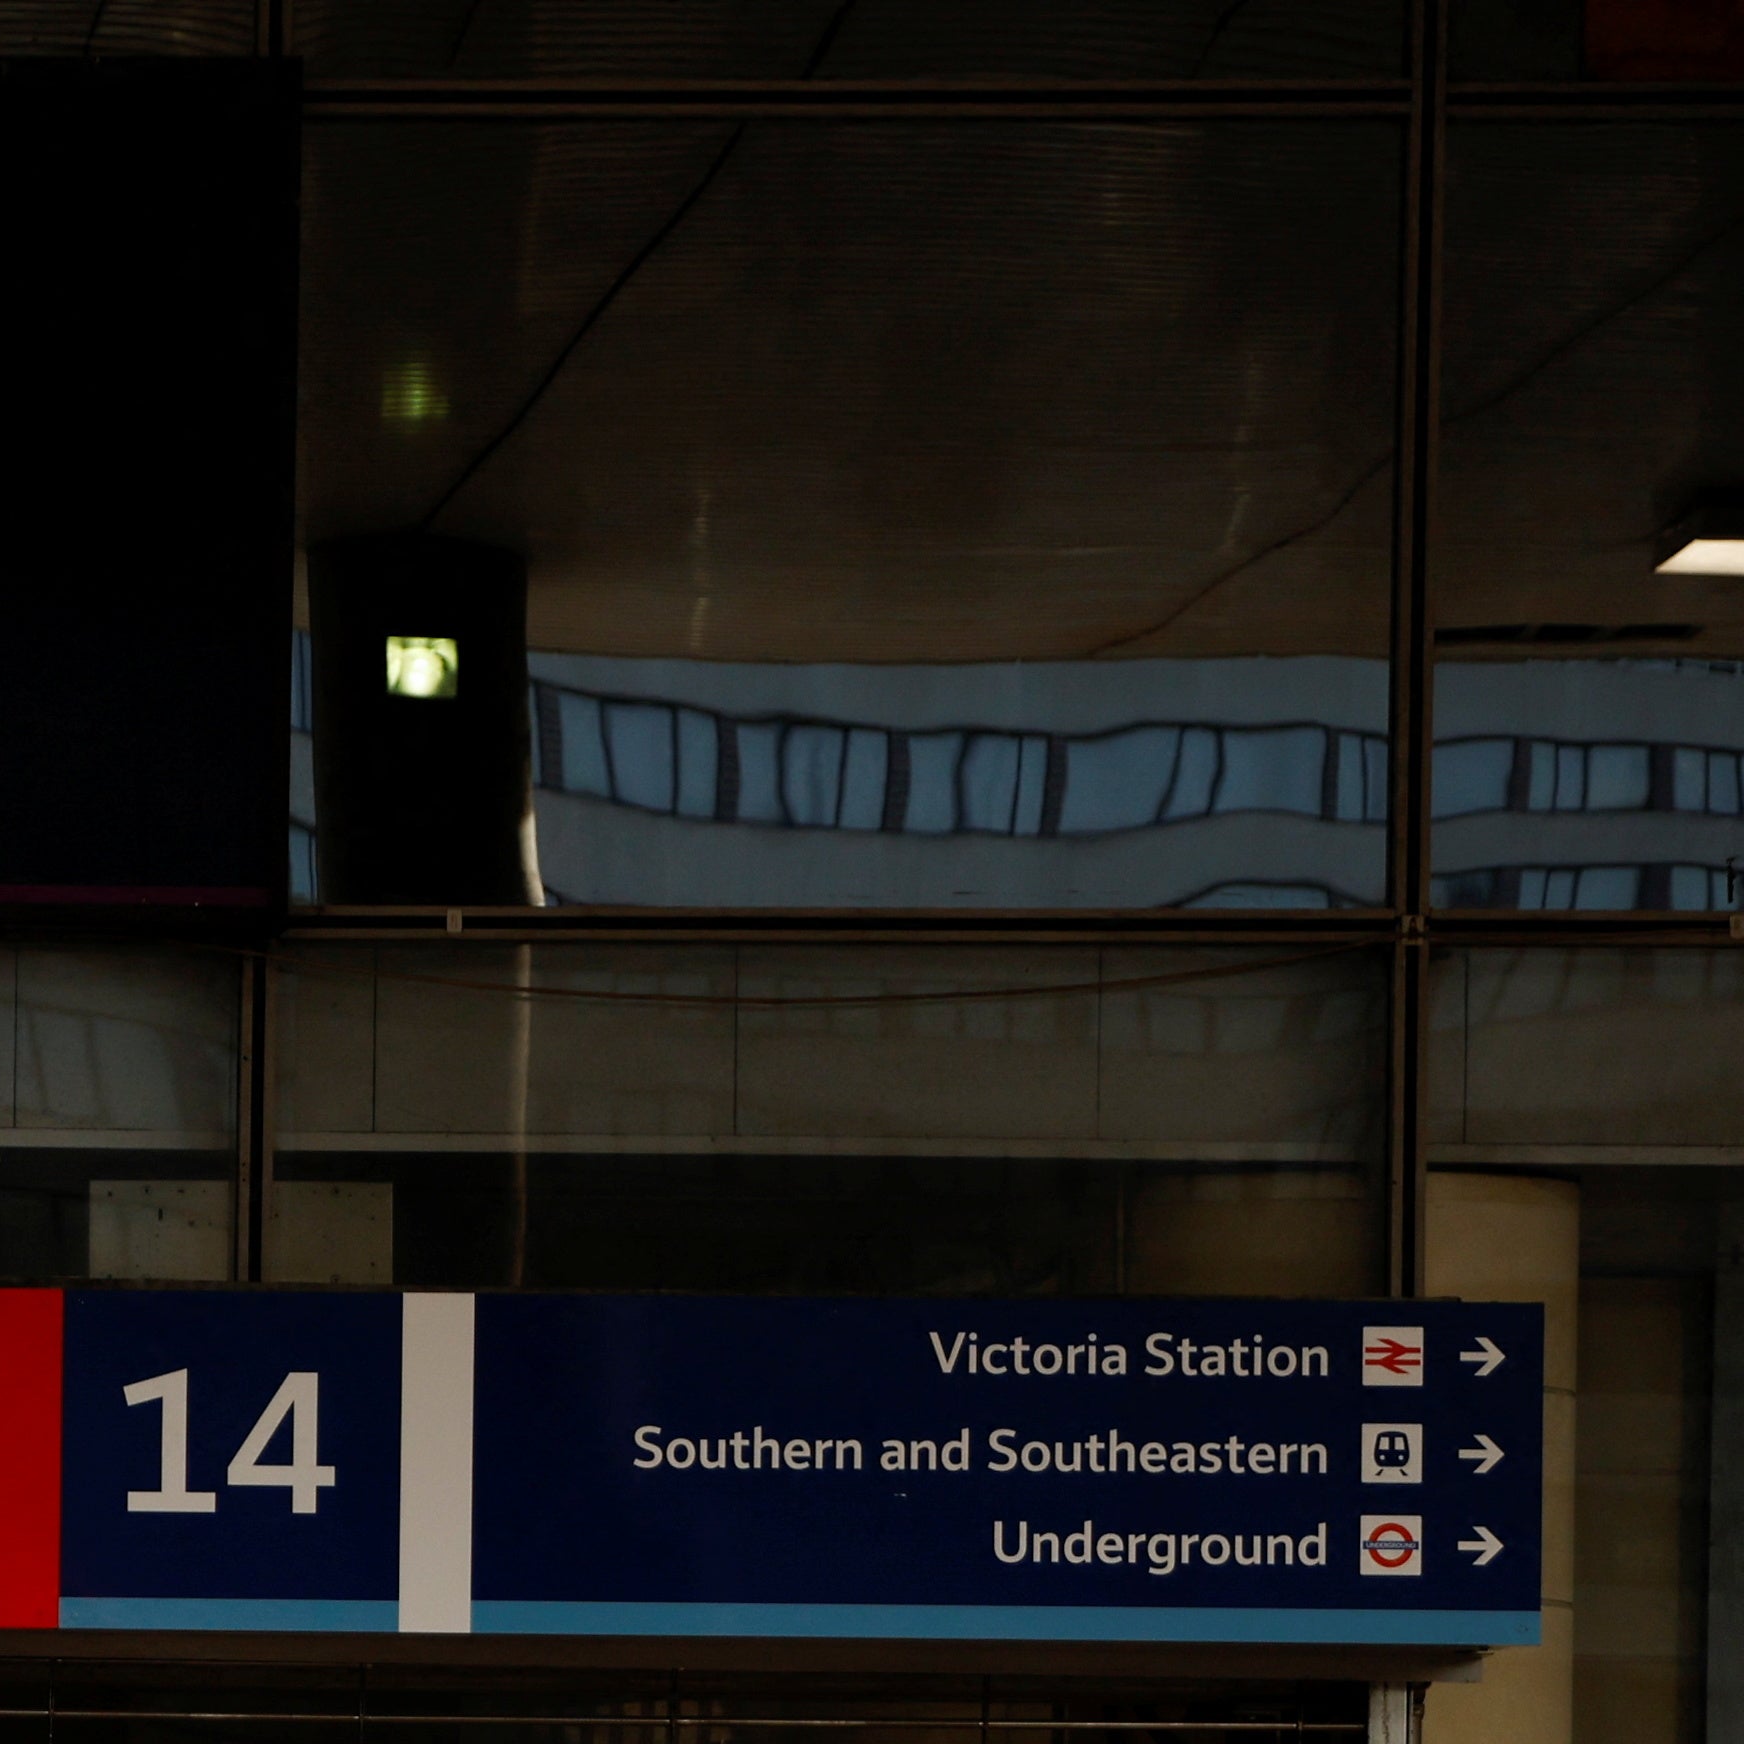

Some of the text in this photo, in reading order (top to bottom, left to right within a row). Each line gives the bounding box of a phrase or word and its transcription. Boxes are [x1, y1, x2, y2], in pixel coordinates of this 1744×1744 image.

[928, 1331, 1330, 1377] Victoria Station
[122, 1367, 337, 1514] 14
[632, 1425, 1329, 1474] Southern and Southeastern
[992, 1519, 1328, 1576] Underground
